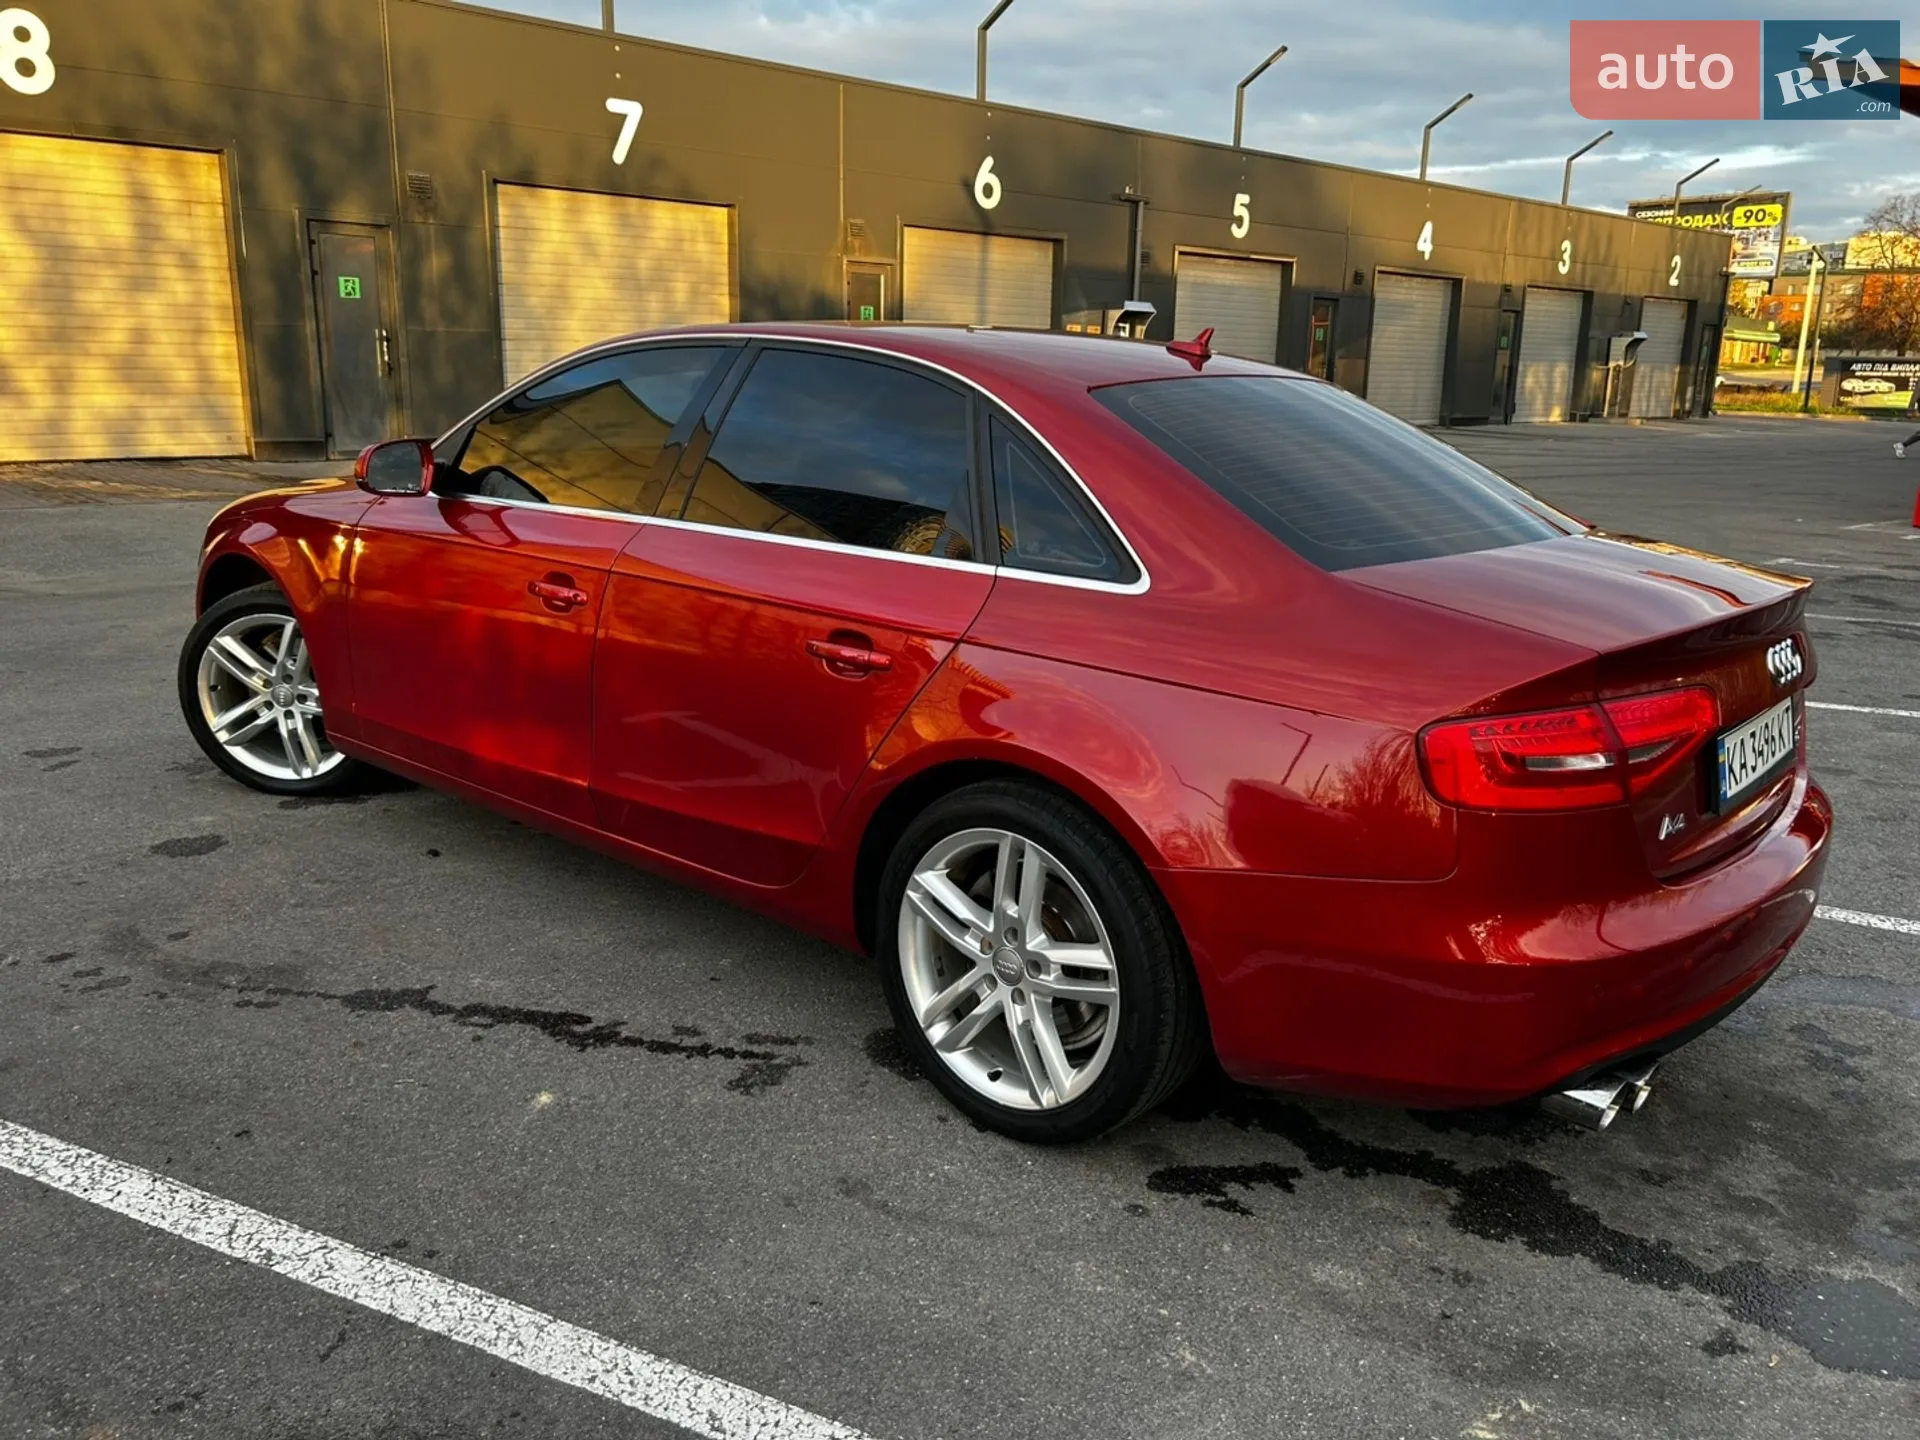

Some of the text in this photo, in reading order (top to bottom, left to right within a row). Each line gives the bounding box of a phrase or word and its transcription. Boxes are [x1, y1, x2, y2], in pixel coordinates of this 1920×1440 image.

[0, 8, 55, 95] 8
[605, 97, 643, 165] 7
[974, 155, 1002, 209] 6
[1230, 193, 1250, 239] 5
[1416, 221, 1433, 261] 4
[1558, 239, 1572, 275] 3
[1669, 254, 1682, 287] 2
[1849, 362, 1873, 371] АВТО
[1658, 813, 1686, 840] A4
